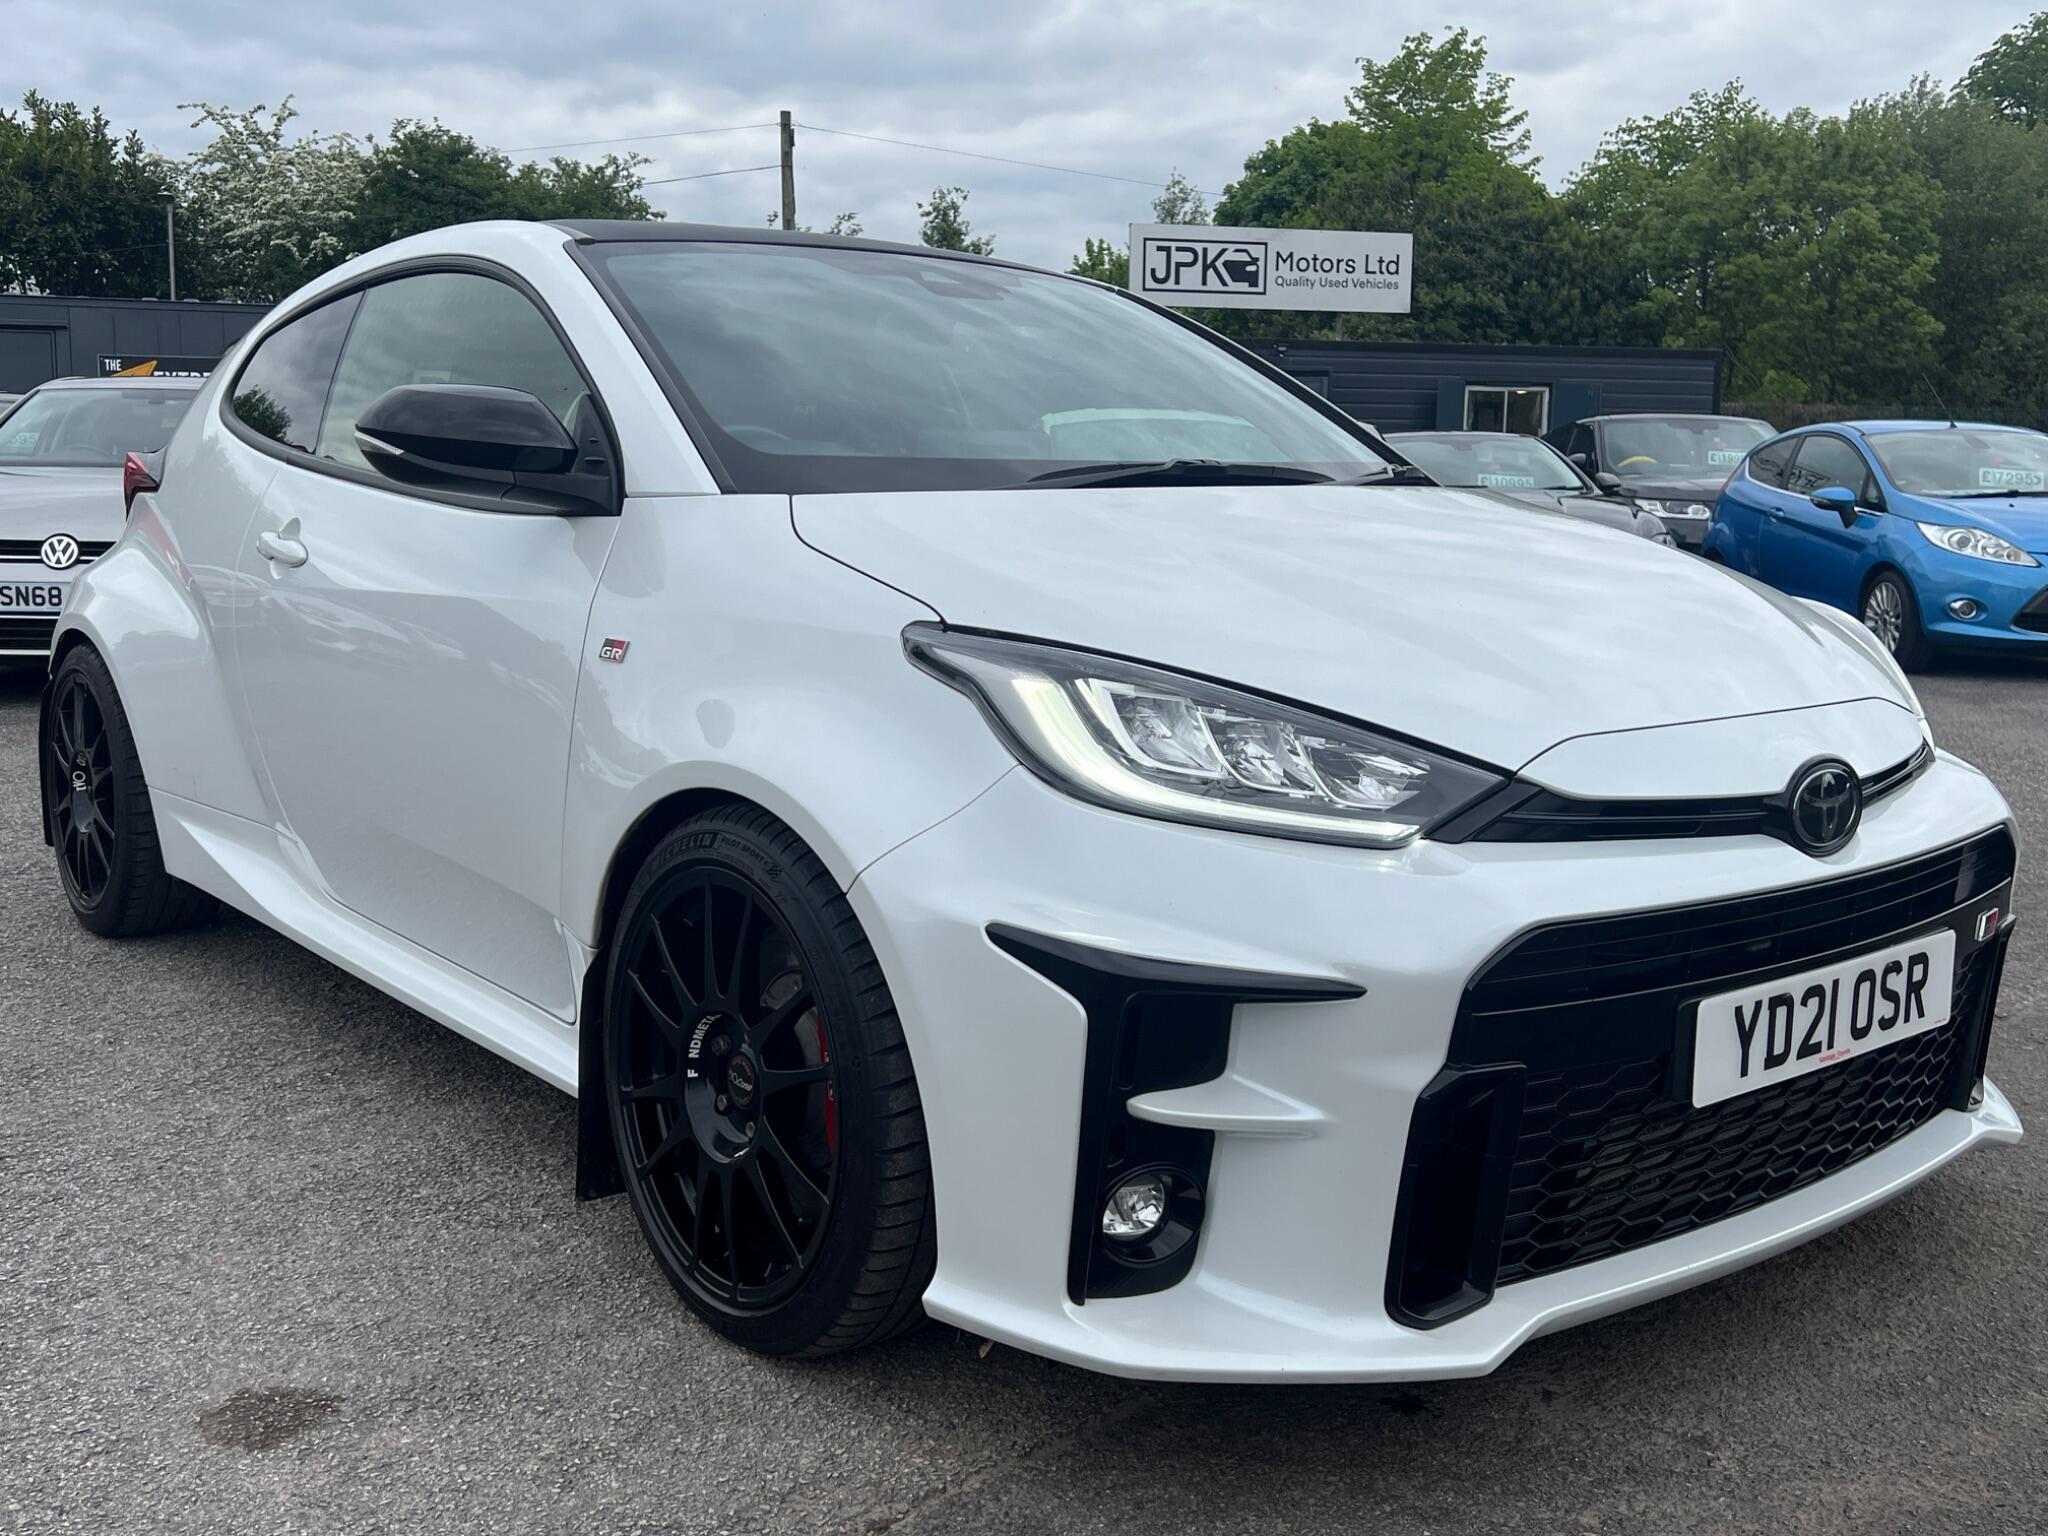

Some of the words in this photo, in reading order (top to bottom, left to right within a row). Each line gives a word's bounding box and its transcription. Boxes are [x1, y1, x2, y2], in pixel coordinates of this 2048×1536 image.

[1150, 245, 1229, 287] JPK
[1275, 250, 1357, 275] Motors
[1364, 253, 1400, 276] Ltd
[1275, 275, 1316, 290] Quality
[1319, 277, 1349, 288] Used
[1351, 278, 1400, 290] Vehicles
[104, 359, 122, 371] THE
[0, 585, 63, 607] SN68
[601, 646, 624, 660] GR
[1734, 978, 1840, 1079] YD21
[1850, 951, 1929, 1041] OSR
